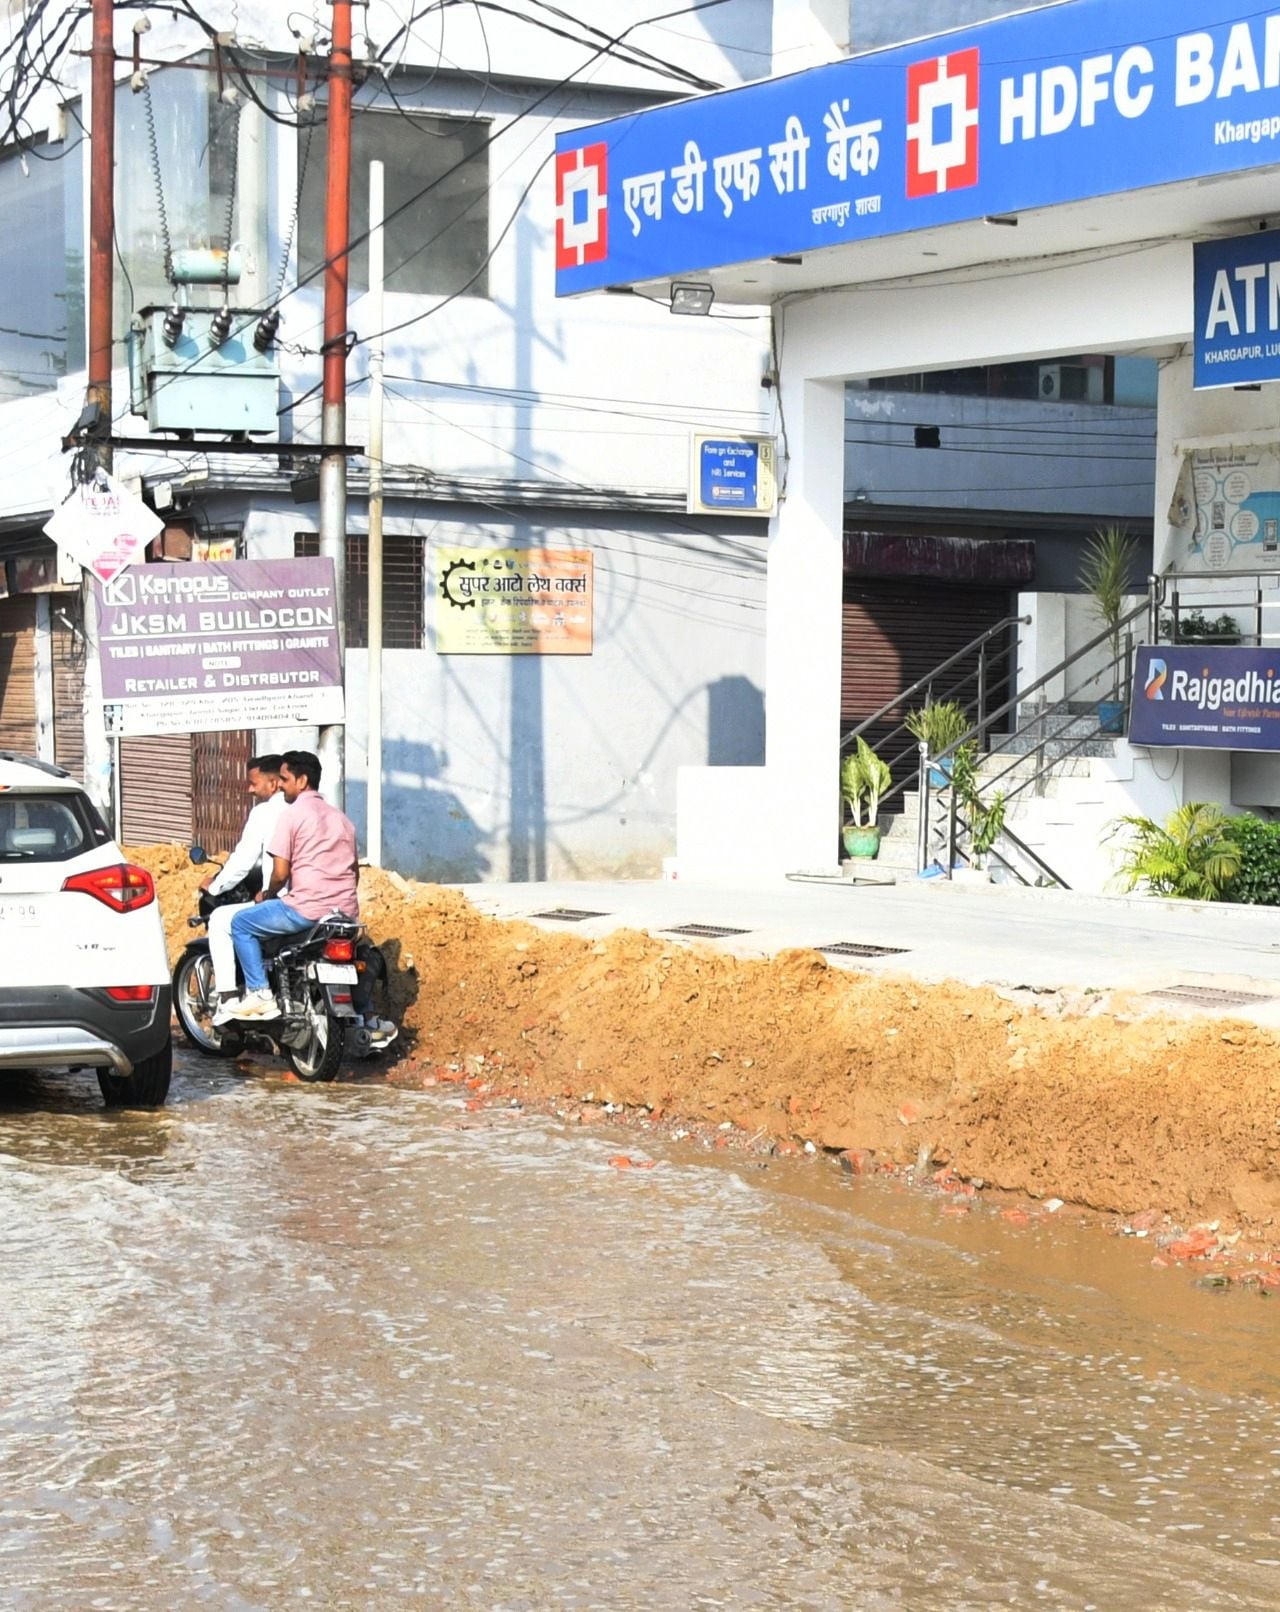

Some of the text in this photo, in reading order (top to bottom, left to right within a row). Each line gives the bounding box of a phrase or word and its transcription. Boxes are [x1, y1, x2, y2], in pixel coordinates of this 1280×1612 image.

[1000, 46, 1154, 144] HDFC
[623, 99, 883, 237] एच डी एफ सी बैंक
[811, 195, 882, 227] खरगापुर शाखा
[1205, 345, 1264, 365] KHARGAPUR,
[723, 458, 736, 467] and
[140, 574, 229, 595] Kanopus
[459, 576, 490, 596] सुपर
[494, 573, 523, 593] आटो
[527, 573, 550, 593] लेथ
[141, 587, 331, 605] TILES COMPANY OUTLET
[112, 607, 334, 635] JKSM BUILDCON
[109, 636, 329, 658] TILES SANITARY BATH FITTINGS GRANITE
[125, 676, 198, 692] RETAILER
[204, 674, 217, 687] &
[1171, 668, 1280, 710] Rajgadhia
